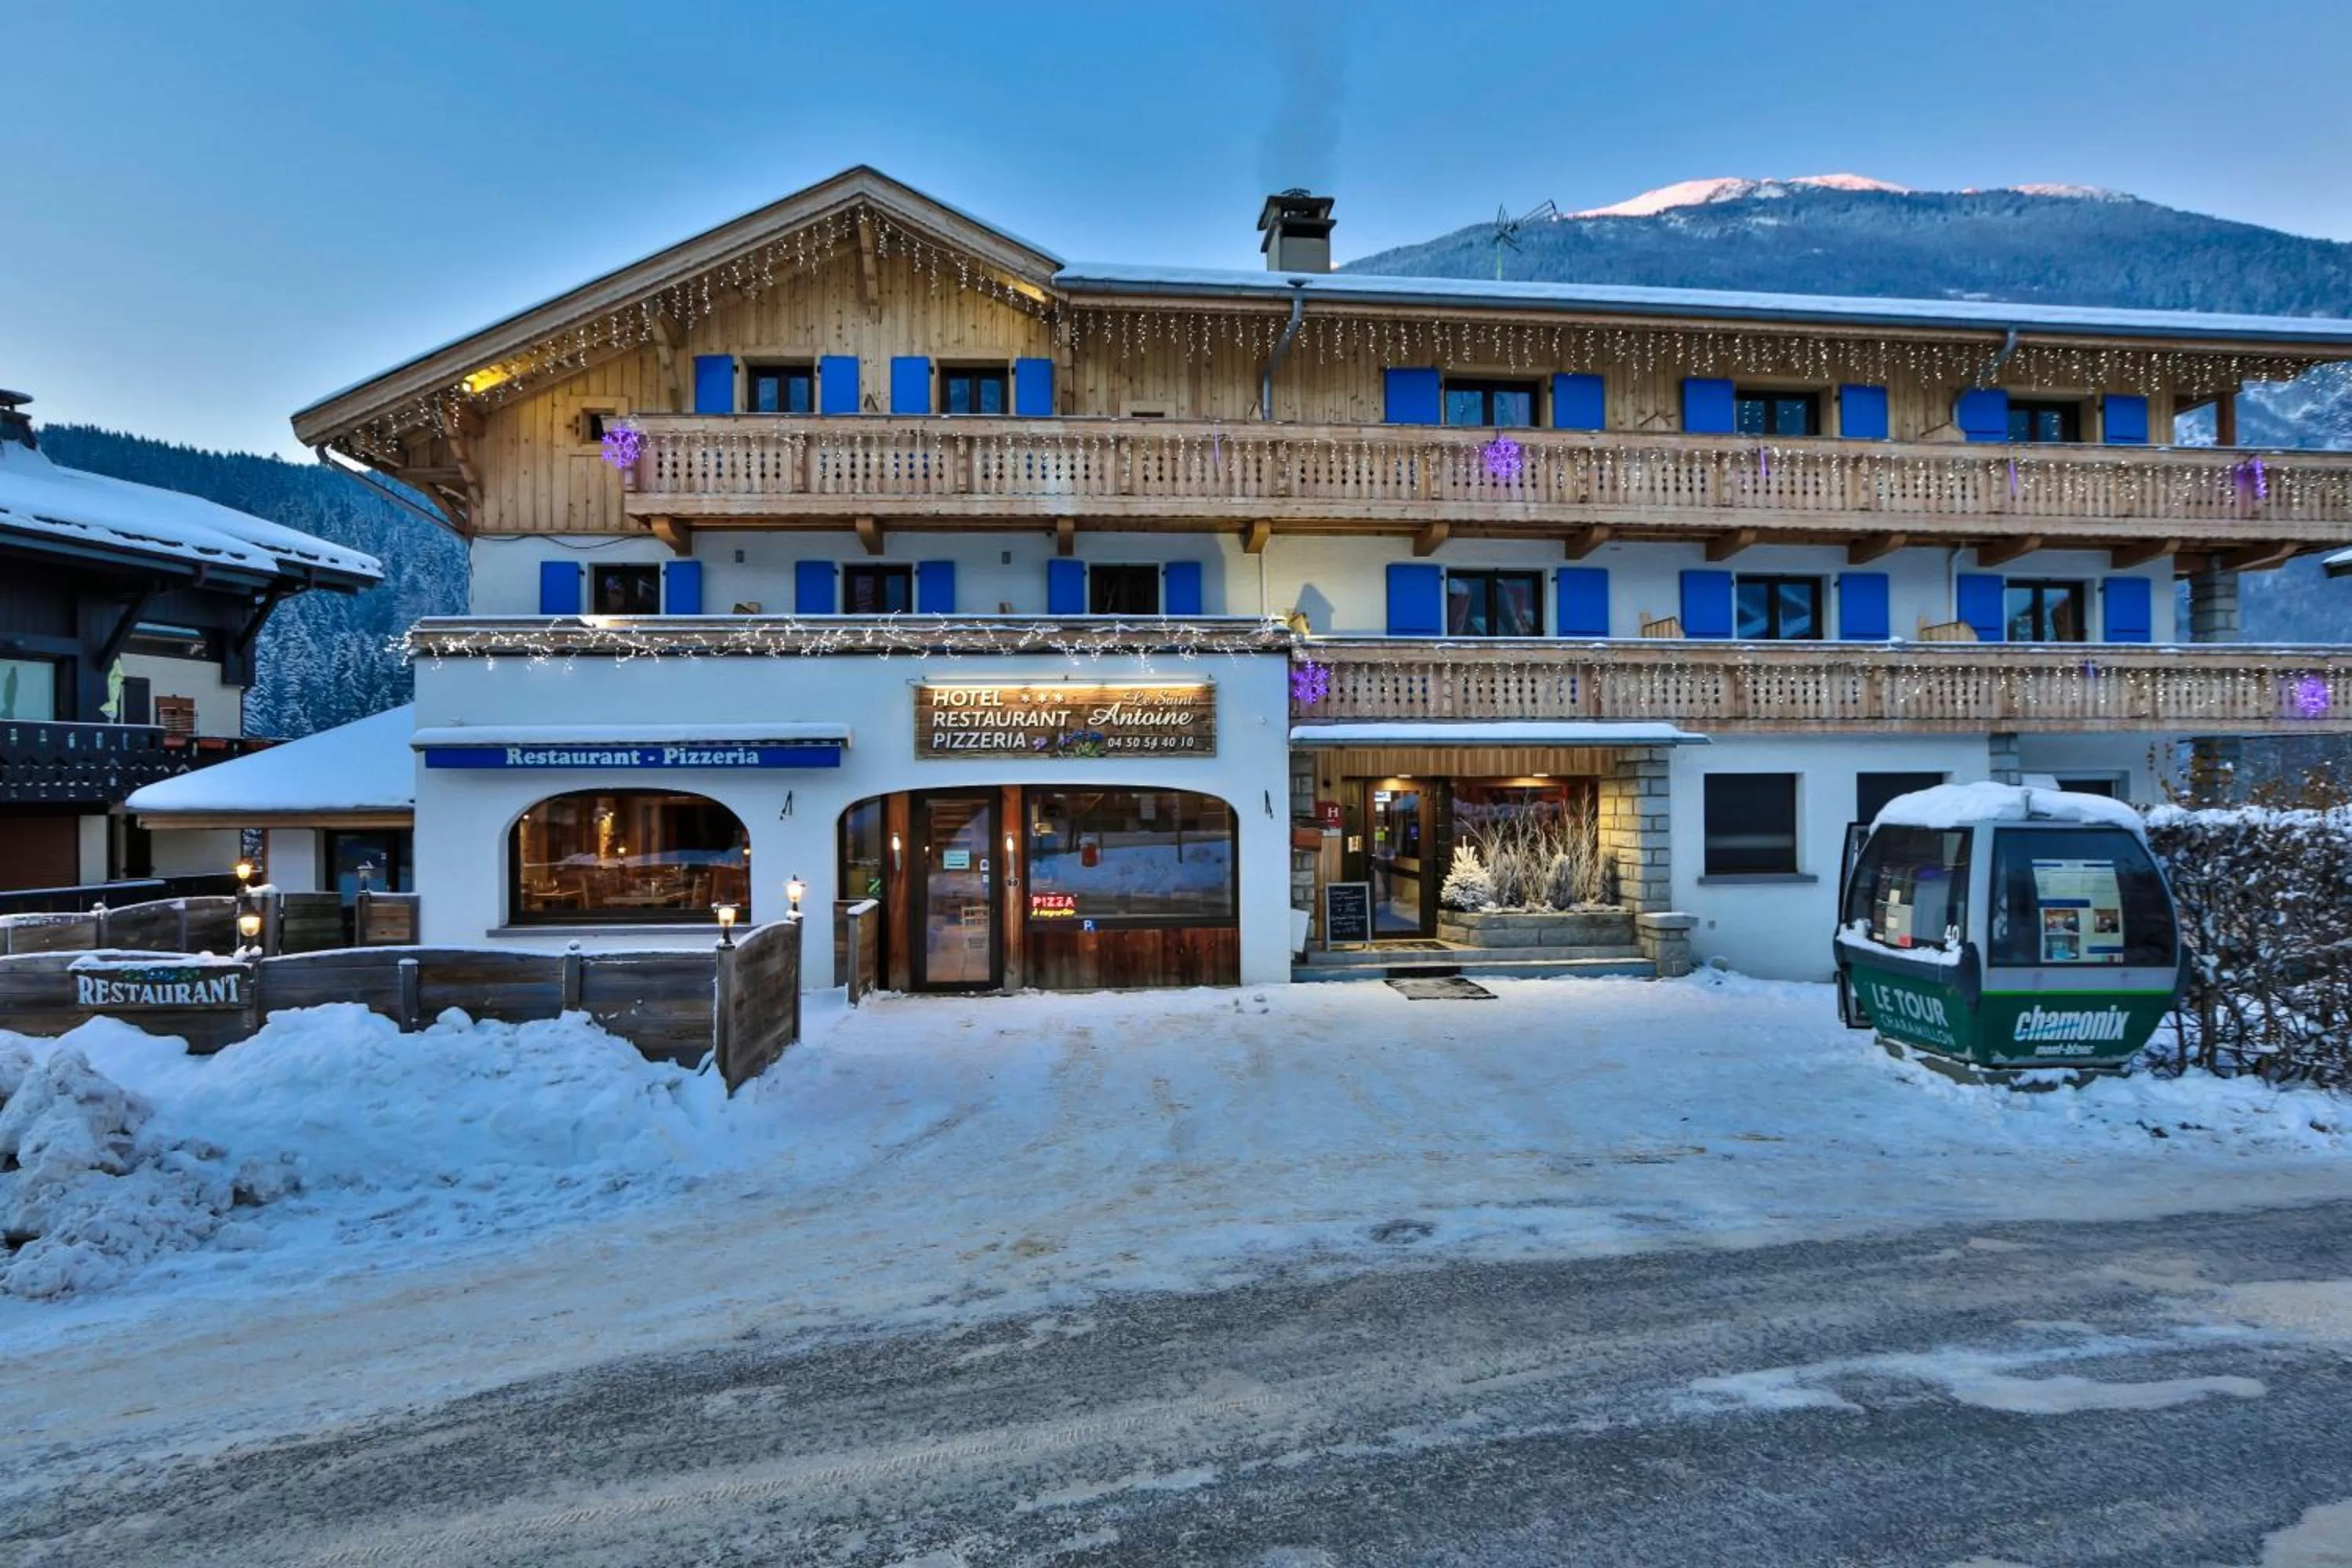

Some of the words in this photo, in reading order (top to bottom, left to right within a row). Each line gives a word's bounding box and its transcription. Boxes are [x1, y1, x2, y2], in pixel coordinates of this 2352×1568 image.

[932, 689, 1004, 706] HOTEL
[1123, 690, 1150, 706] Le
[1155, 690, 1194, 706] Saint
[932, 710, 1072, 728] RESTAURANT
[1087, 700, 1194, 726] Antoine
[932, 731, 1027, 749] PIZZERIA
[1108, 737, 1122, 748] 04
[1126, 737, 1141, 747] 50
[1161, 737, 1176, 747] 40
[1181, 736, 1194, 747] 10
[506, 747, 641, 765] Restaurant
[662, 747, 760, 764] Pizzeria
[1327, 807, 1339, 818] H
[1033, 896, 1075, 907] PIZZA
[77, 973, 241, 1004] RESTAURANT
[1871, 982, 1894, 1012] LE
[1893, 988, 1949, 1028] TOUR
[2013, 1004, 2131, 1041] chamonix
